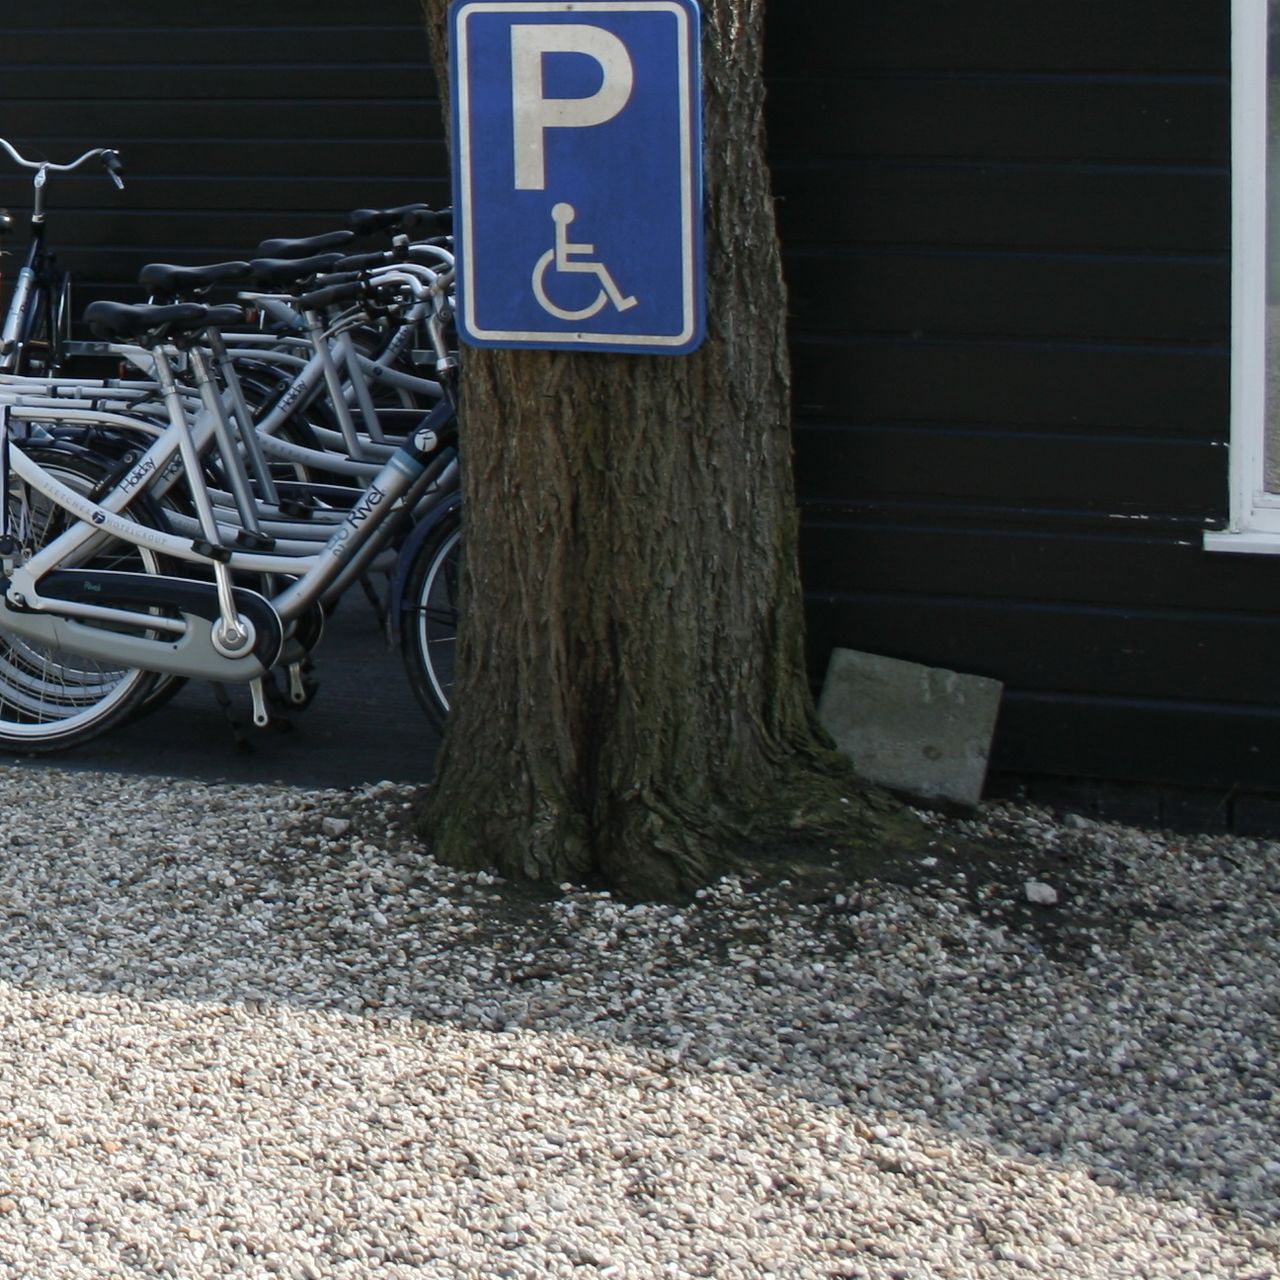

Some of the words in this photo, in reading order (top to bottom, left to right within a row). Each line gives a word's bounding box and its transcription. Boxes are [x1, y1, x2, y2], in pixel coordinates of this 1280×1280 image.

[510, 23, 634, 191] P
[120, 458, 157, 494] Holiday
[345, 484, 386, 530] Rivel
